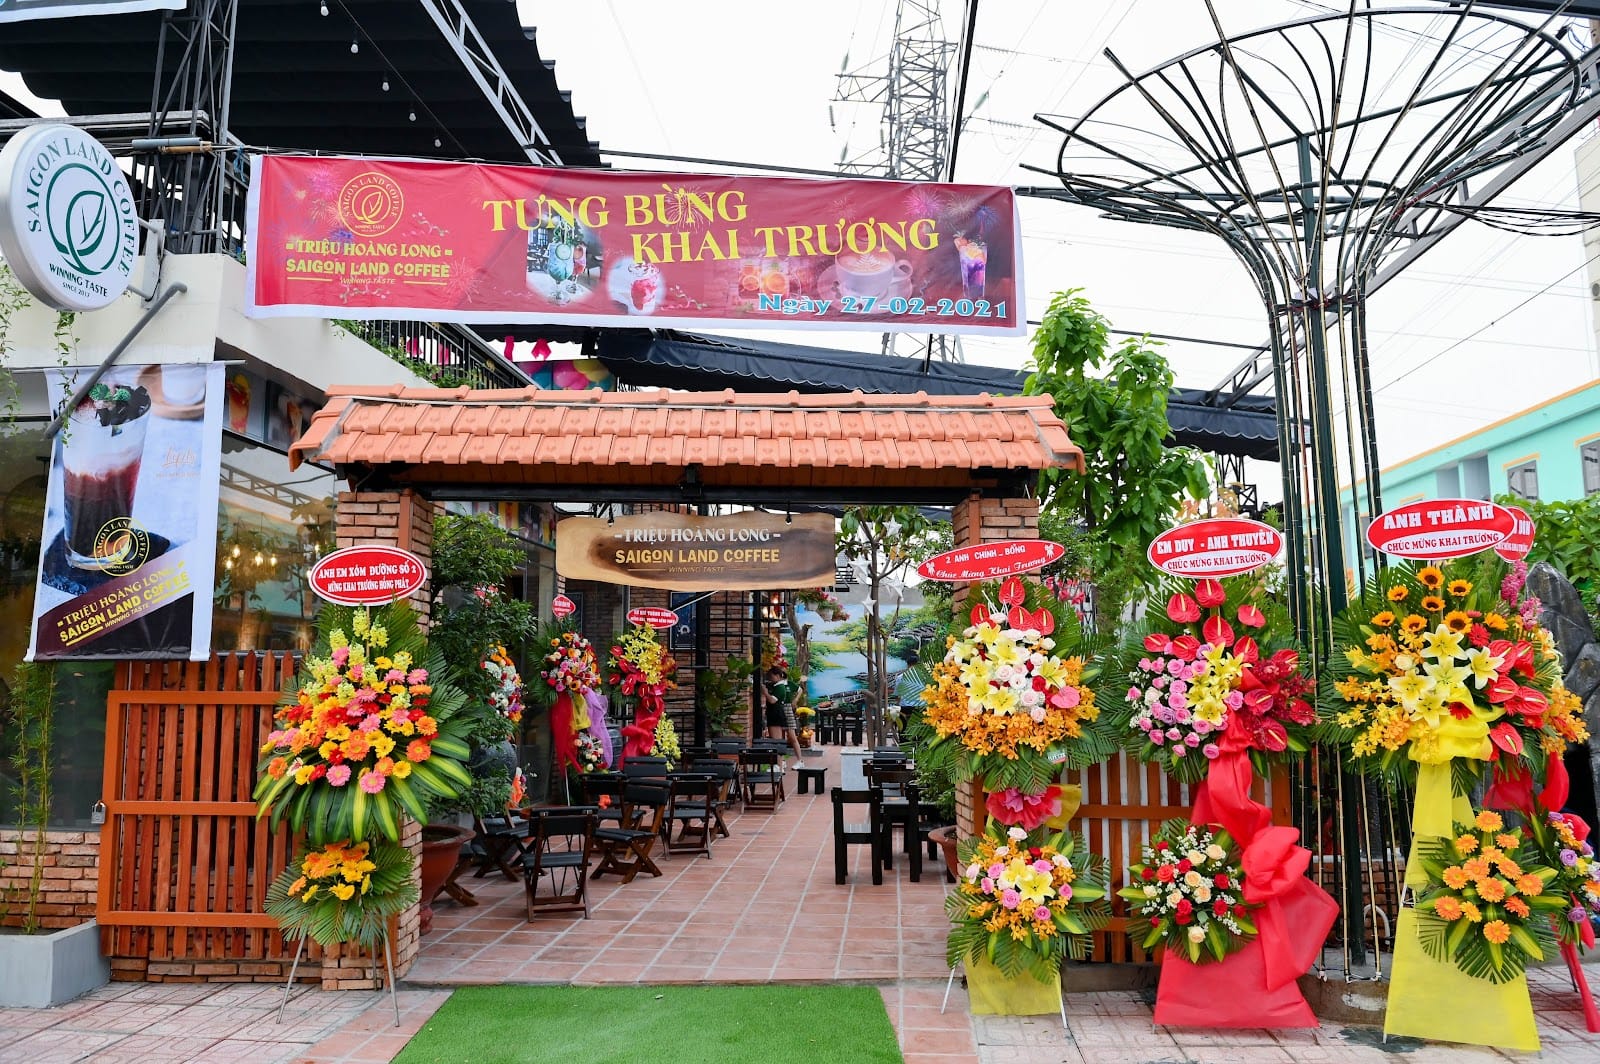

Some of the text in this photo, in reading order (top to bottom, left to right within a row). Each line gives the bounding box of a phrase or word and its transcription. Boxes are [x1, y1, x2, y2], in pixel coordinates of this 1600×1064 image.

[26, 137, 135, 278] SAIGON LAND COFFEE
[482, 183, 748, 231] TƯNG BỪNG
[296, 239, 442, 258] TRIỆU HOÀNG LONG
[631, 217, 940, 264] KHAI TRƯƠNG
[286, 259, 450, 278] SAIGON LAND COFFEE
[49, 263, 108, 297] WINNING TASTE
[758, 293, 1007, 318] Ngày 27-02-2021
[1383, 505, 1495, 530] ANH THÀNH
[624, 525, 770, 545] TRIỆU HOÀNG LONG
[1156, 540, 1172, 554] EM
[1174, 538, 1194, 552] DUY
[1207, 535, 1228, 550] ANH
[1387, 539, 1410, 552] CHÚC
[1439, 537, 1462, 548] KHAI
[1463, 532, 1499, 545] TRƯƠNG
[615, 548, 780, 564] SAIGON LAND COFFEE
[945, 556, 951, 564] 2
[954, 553, 970, 563] ANH
[974, 546, 997, 560] CHÍNH
[1213, 556, 1233, 566] KHAI
[318, 568, 335, 579] ANH
[336, 567, 347, 578] EM
[99, 581, 141, 608] HOÀNG
[60, 614, 106, 642] SAIGON
[108, 595, 141, 619] LAND
[104, 603, 149, 628] WINNING TASTE
